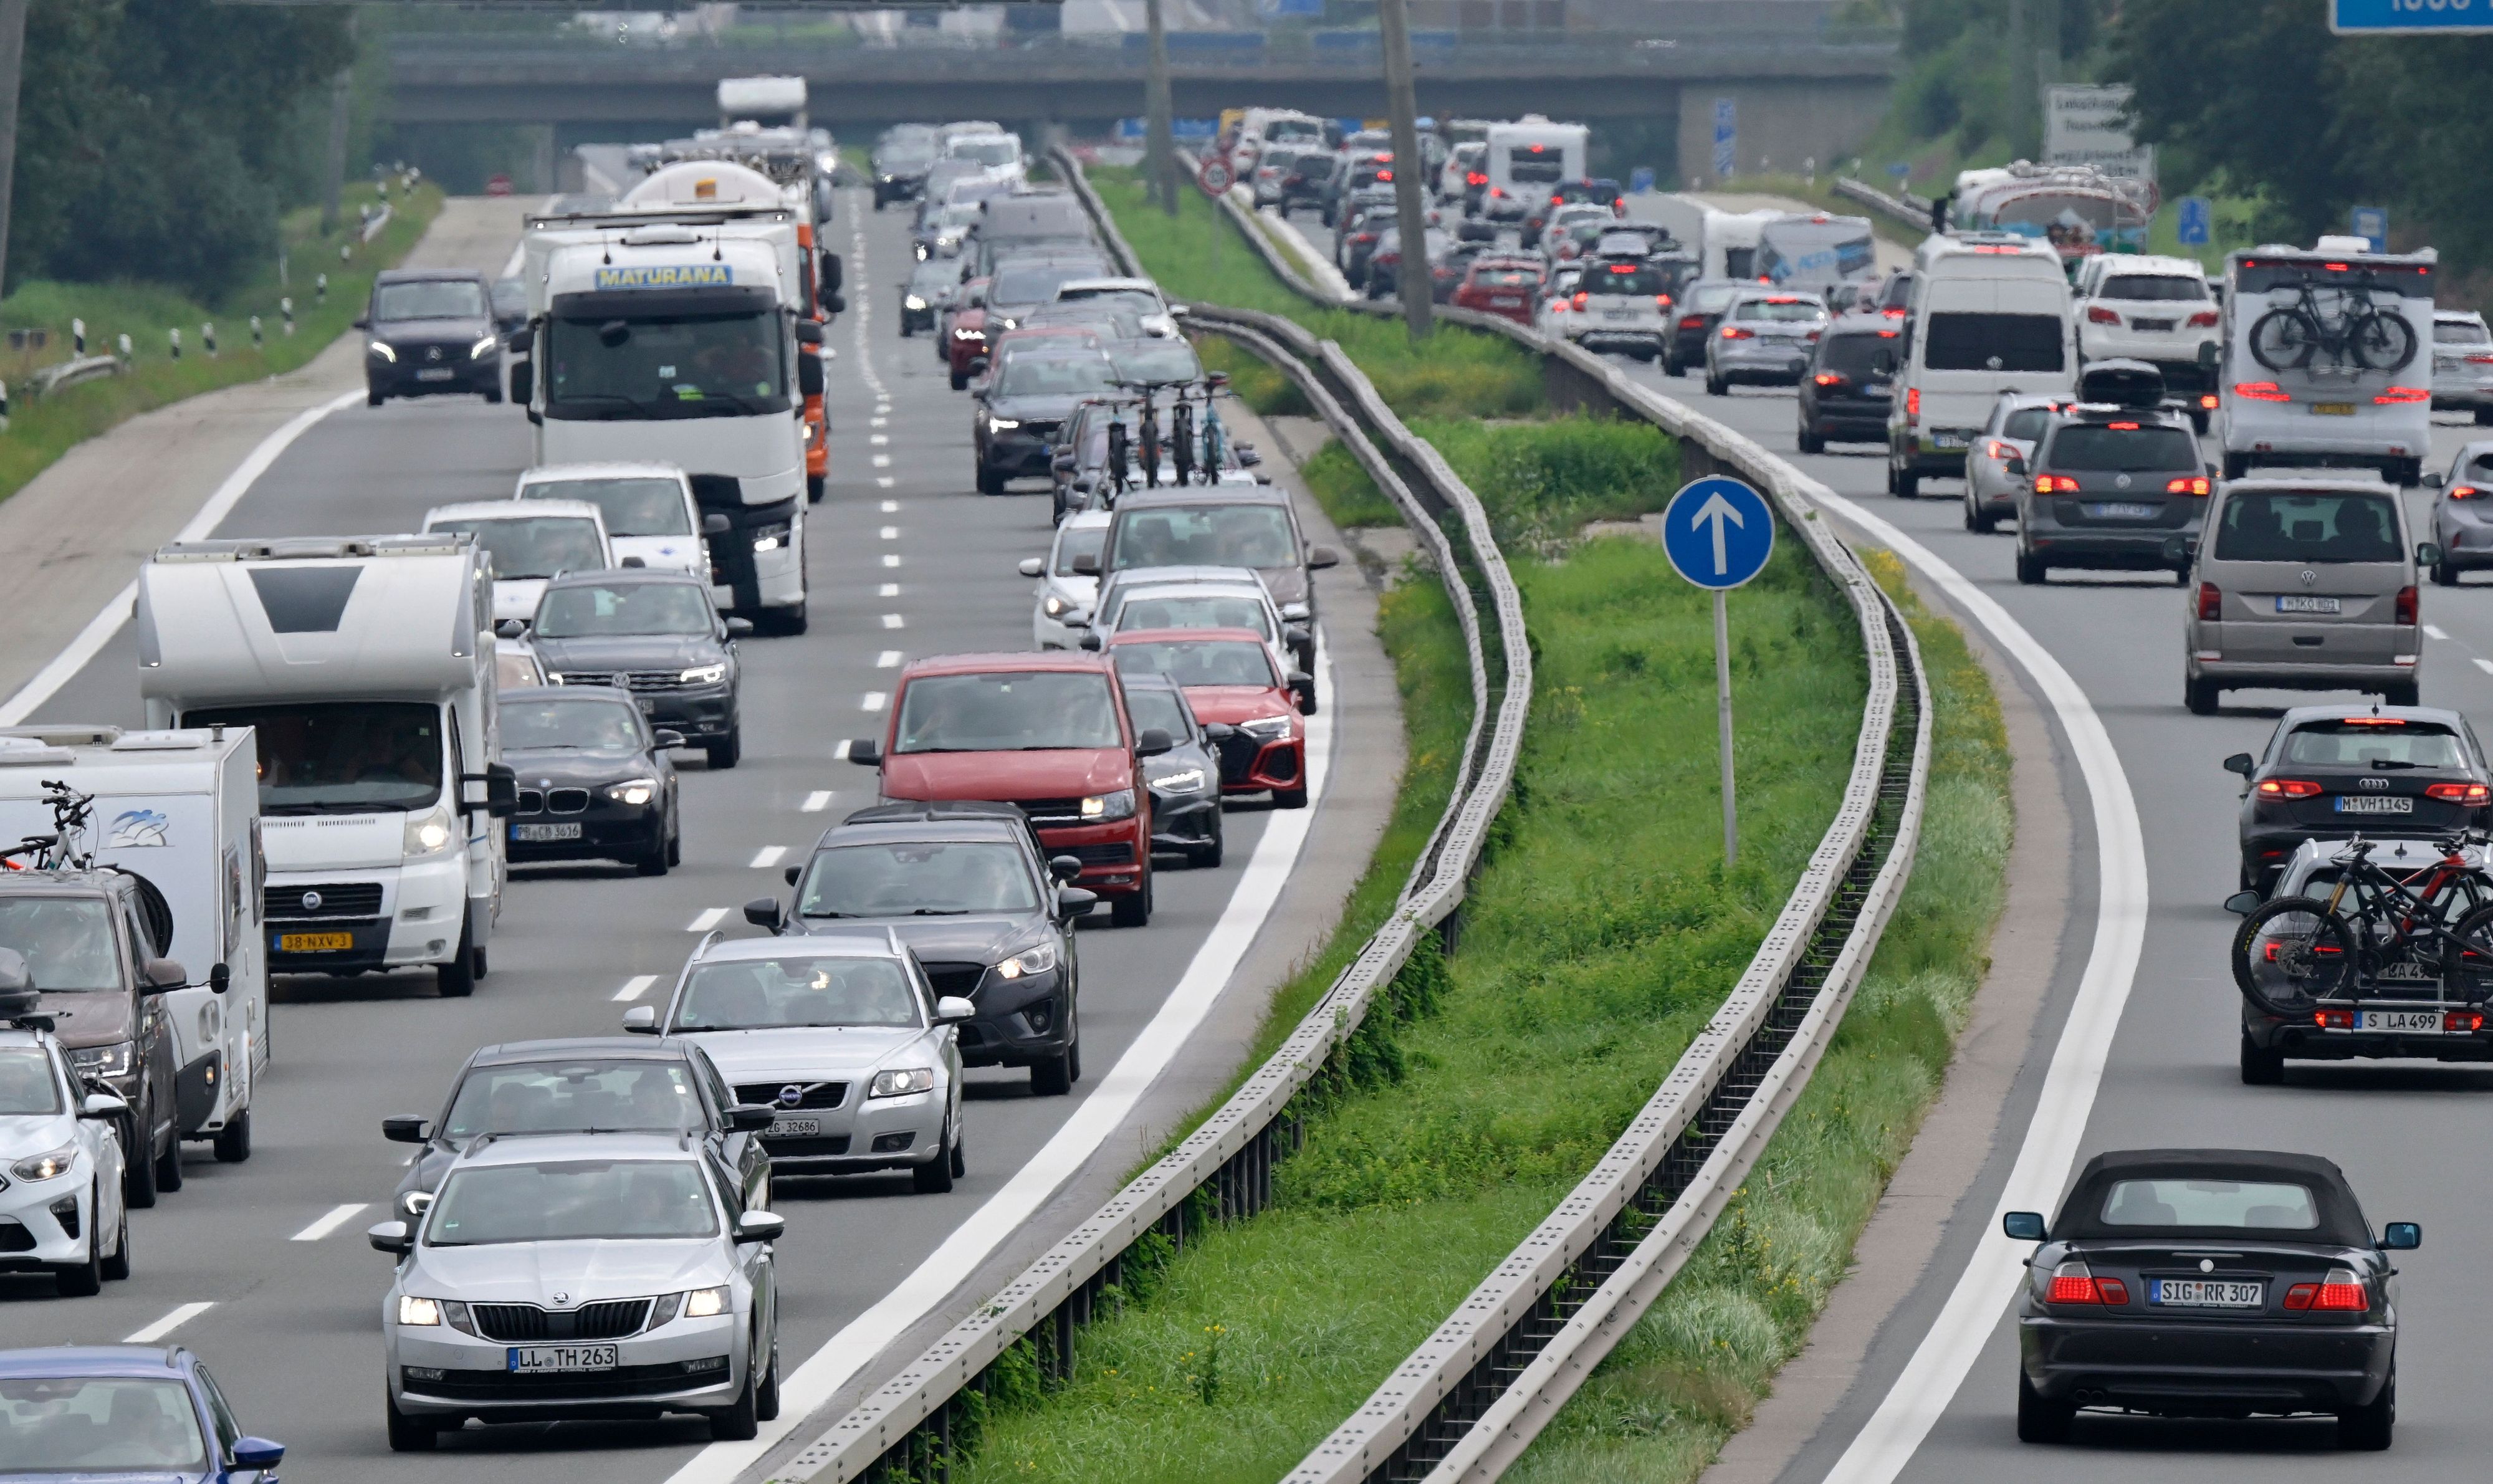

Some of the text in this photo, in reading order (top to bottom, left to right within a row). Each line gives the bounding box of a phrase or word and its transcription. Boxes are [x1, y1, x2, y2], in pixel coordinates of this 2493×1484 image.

[600, 267, 728, 285] MATURANA
[2343, 798, 2350, 810] M
[2368, 1013, 2378, 1027] S
[787, 1121, 815, 1132] 32686
[2163, 1282, 2192, 1300] SIG
[2229, 1285, 2259, 1302] 307
[520, 1351, 542, 1367] LL
[581, 1348, 614, 1365] 263
